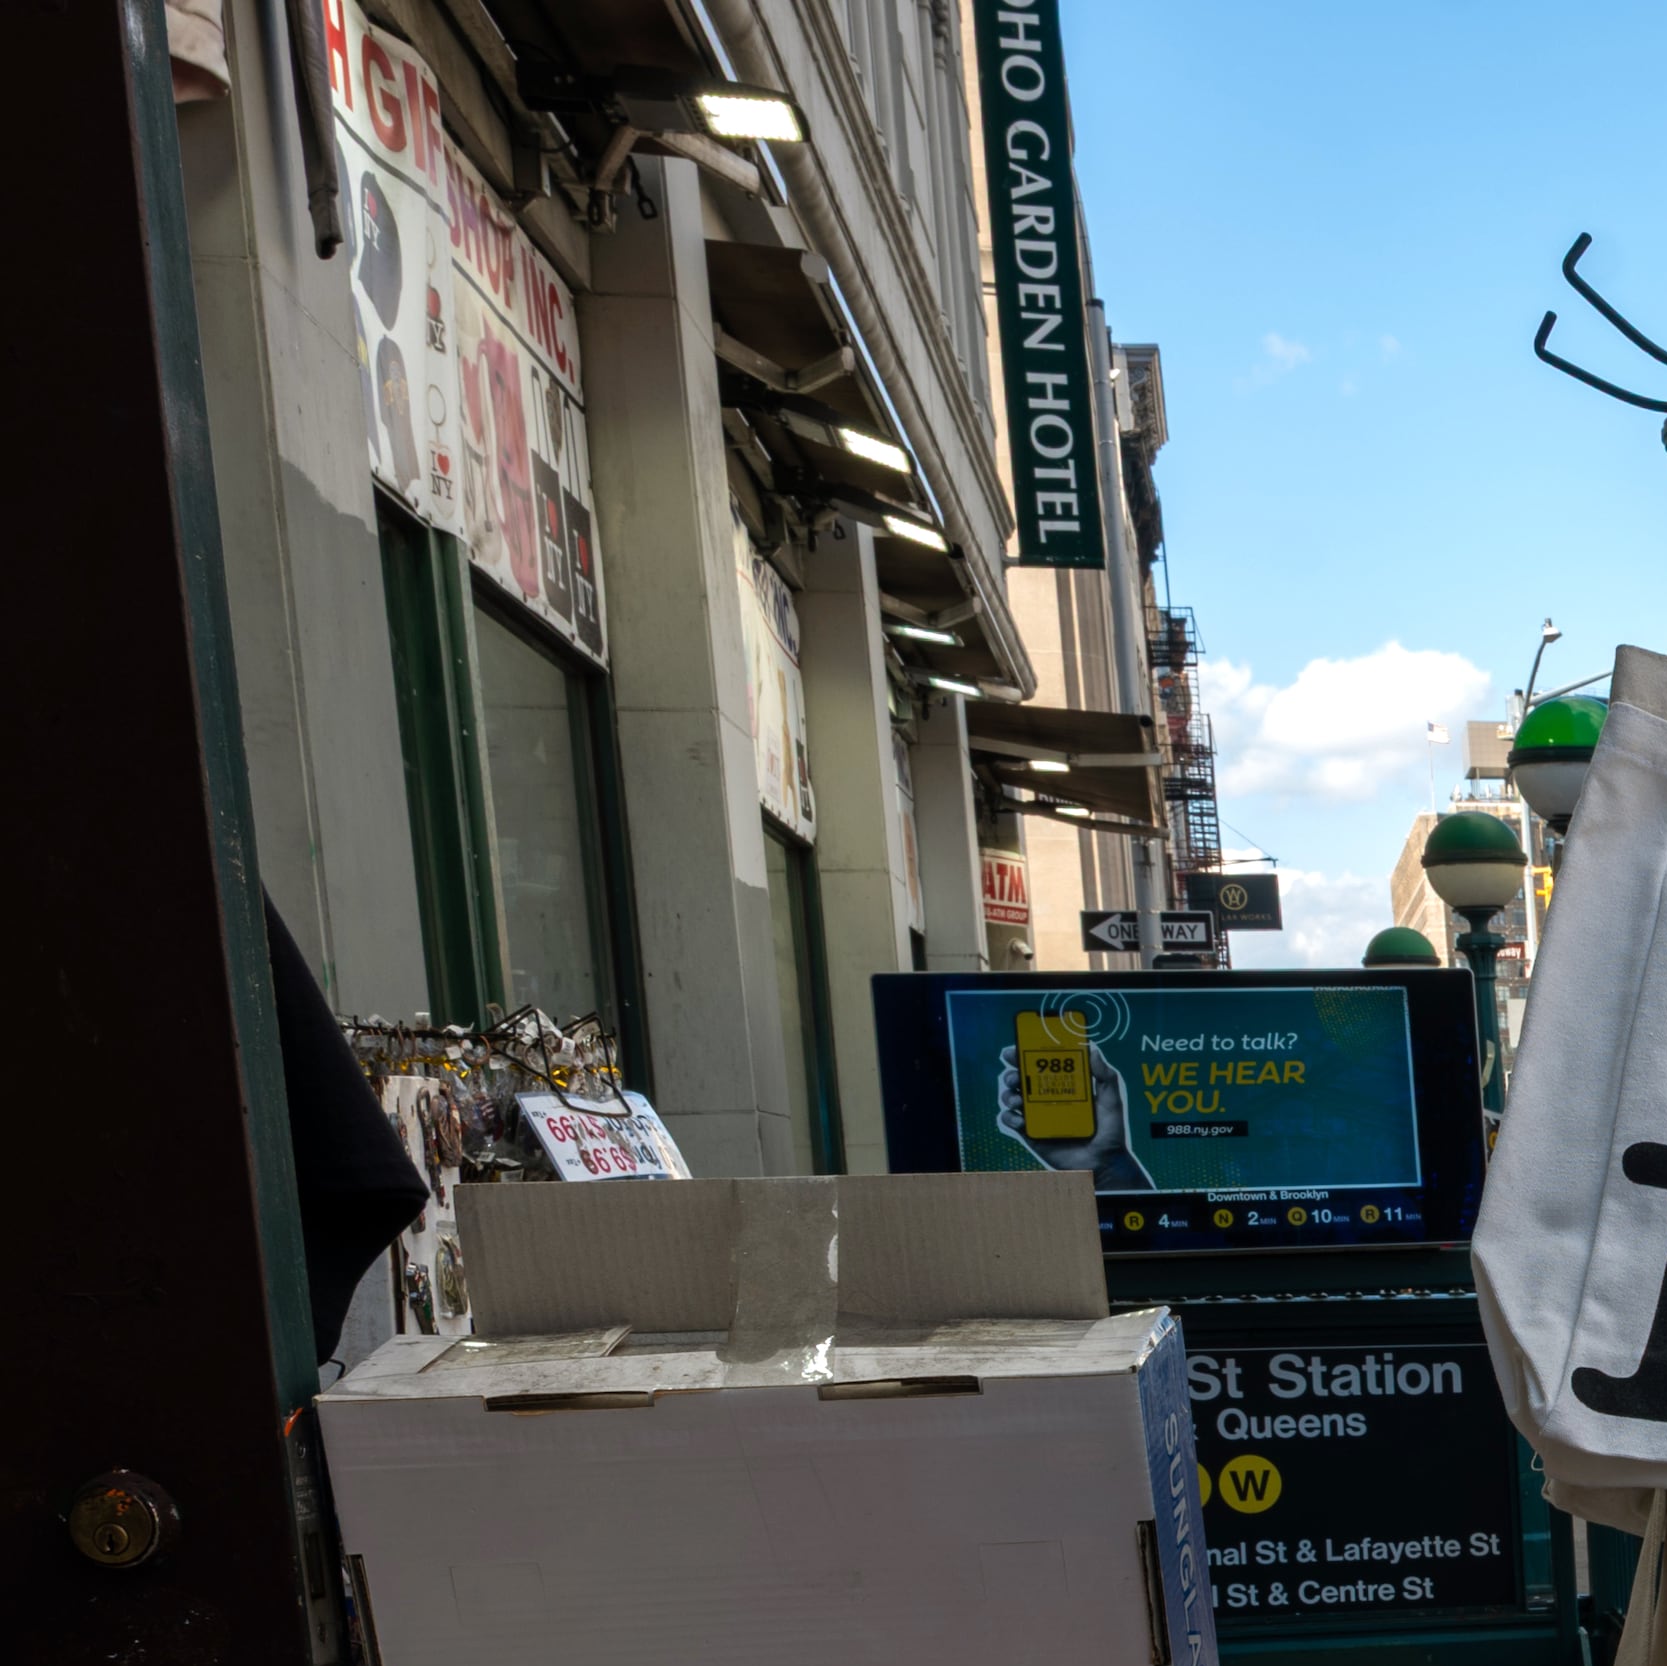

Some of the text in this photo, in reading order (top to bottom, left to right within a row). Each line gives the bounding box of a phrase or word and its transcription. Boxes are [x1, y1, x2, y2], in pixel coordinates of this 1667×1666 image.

[361, 33, 441, 186] GIF
[521, 245, 575, 385] INC.
[1006, 119, 1080, 545] GARDEN HOTEL
[982, 862, 1027, 905] ATM
[1108, 923, 1197, 941] ONE WAY
[1141, 1032, 1298, 1051] Need to talk?
[1036, 1058, 1075, 1073] 988
[1141, 1060, 1305, 1086] WE HEAR
[1144, 1089, 1226, 1114] YOU.
[1166, 1124, 1234, 1137] 988.ny.gov
[580, 1146, 638, 1176] $9.99
[1207, 1188, 1329, 1203] Downtown & Brooklyn
[1158, 1213, 1169, 1228] 4
[1247, 1211, 1259, 1226] 2
[1311, 1208, 1332, 1224] 10
[1384, 1207, 1402, 1221] 11
[1188, 1352, 1463, 1401] St Station
[1216, 1407, 1368, 1441] Queens
[1228, 1469, 1271, 1503] W
[1207, 1532, 1501, 1566] nal St & Lafayette St
[1226, 1585, 1260, 1609] St
[1267, 1583, 1289, 1606] &
[1297, 1580, 1396, 1605] Centre
[1401, 1577, 1435, 1601] St
